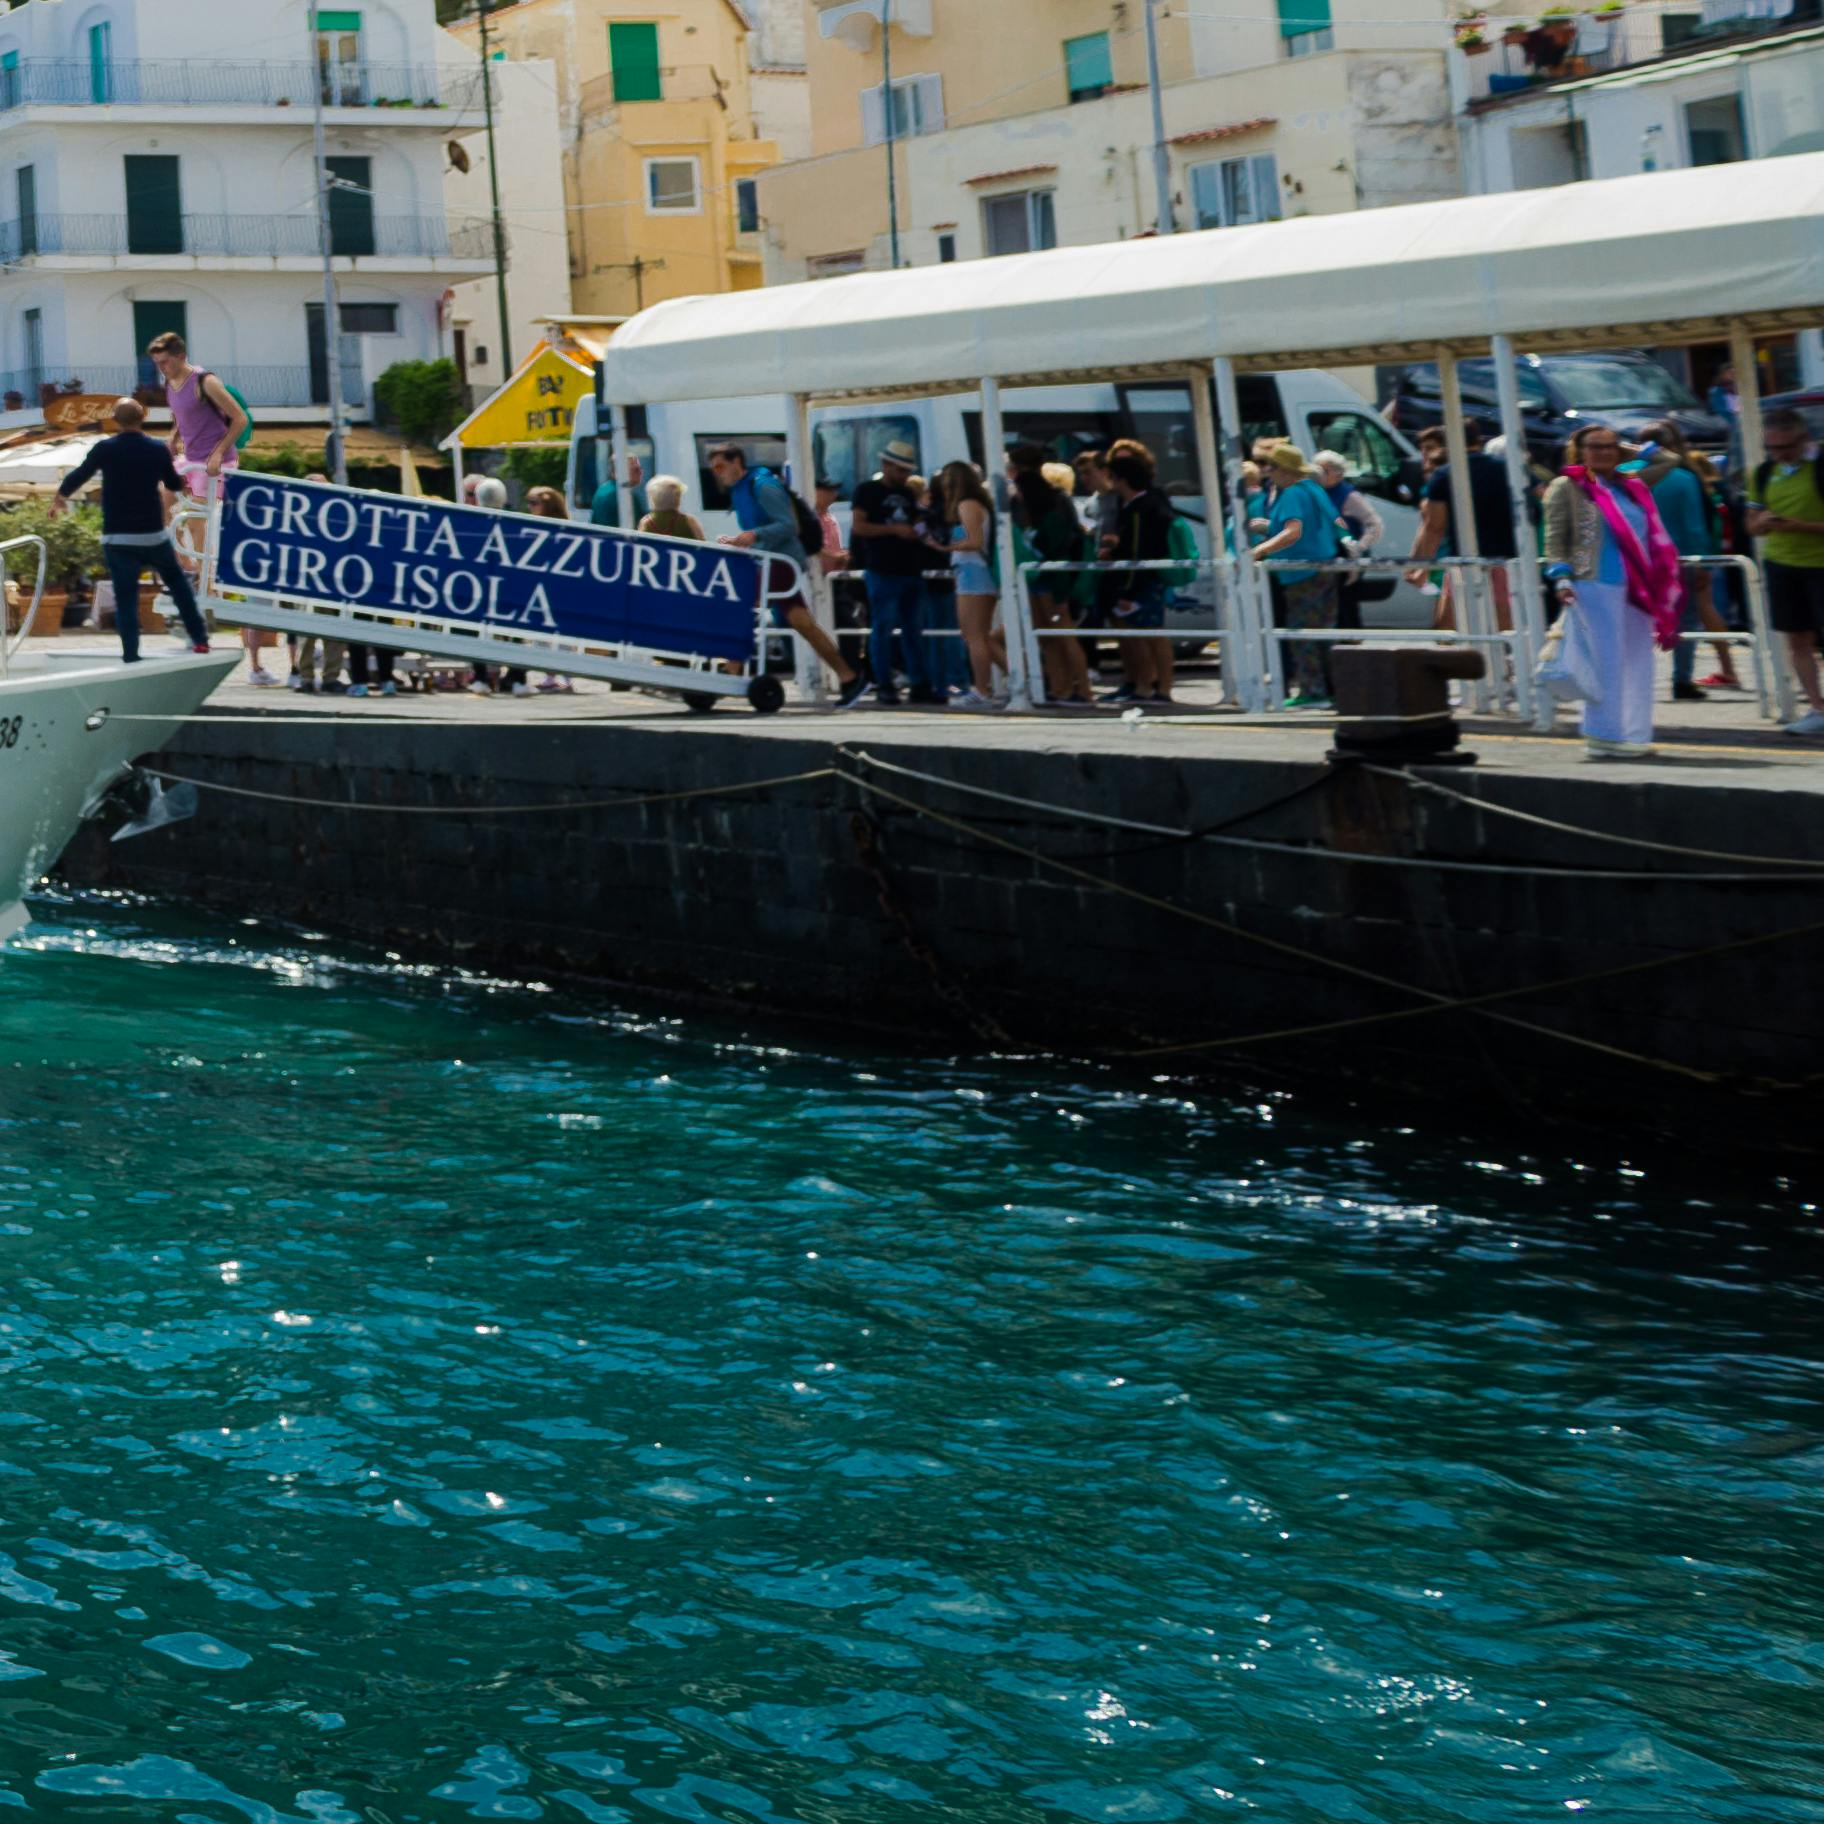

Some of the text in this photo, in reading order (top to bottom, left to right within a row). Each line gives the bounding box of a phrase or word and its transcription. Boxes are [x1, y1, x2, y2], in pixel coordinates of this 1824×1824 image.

[232, 538, 557, 627] GIRO ISOLA
[236, 485, 741, 602] GROTTA AZZURRA
